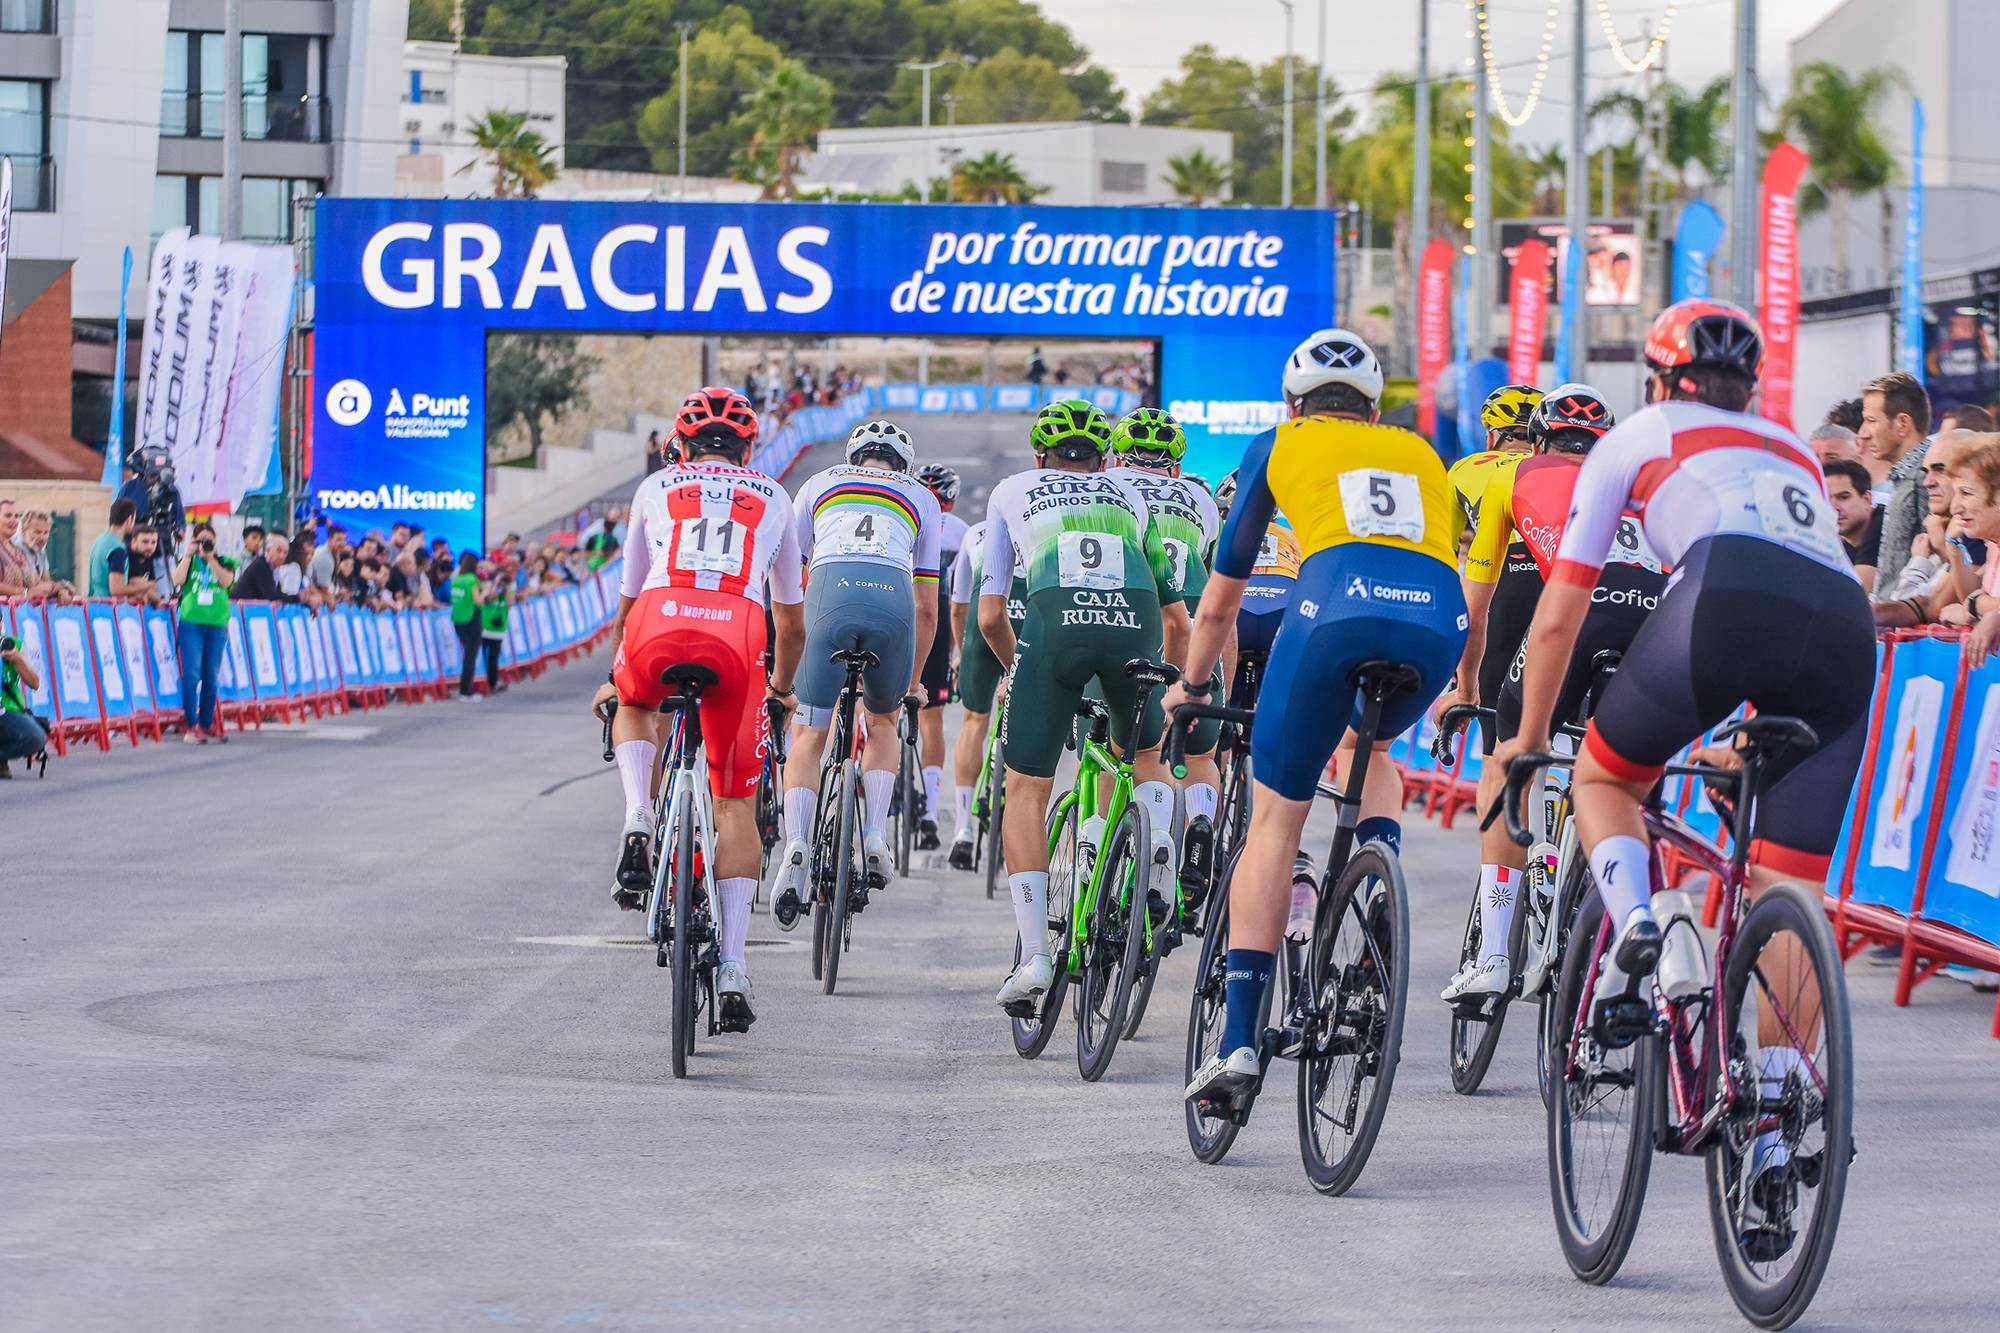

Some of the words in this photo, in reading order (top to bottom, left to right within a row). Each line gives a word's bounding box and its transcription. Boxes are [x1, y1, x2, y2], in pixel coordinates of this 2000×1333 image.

[925, 231, 1006, 274] por
[1008, 221, 1163, 267] formar
[1160, 230, 1284, 277] parte
[361, 221, 834, 314] GRACIAS
[1766, 193, 1795, 344] CRITERIUM
[889, 270, 946, 314] de
[951, 277, 1117, 317] nuestra
[1122, 272, 1290, 318] historia
[142, 288, 168, 446] ODIUM
[164, 290, 196, 448] ODIUM
[385, 388, 407, 416] À
[412, 394, 470, 416] Punt
[661, 474, 774, 498] LOULETANO
[1124, 477, 1194, 494] AJA
[1369, 476, 1397, 517] 5
[1022, 495, 1092, 522] SEGUROS
[1782, 485, 1815, 528] 6
[691, 518, 735, 555] 11
[855, 514, 875, 541] 4
[1522, 516, 1561, 562] Cofidis
[1079, 537, 1103, 569] 9
[855, 580, 896, 592] CORTIZO
[1073, 591, 1130, 608] CAJA
[1373, 584, 1432, 604] CORTIZO
[1590, 586, 1661, 611] Cofid
[679, 604, 734, 621] IMOPROMO
[1061, 609, 1142, 630] RURAL
